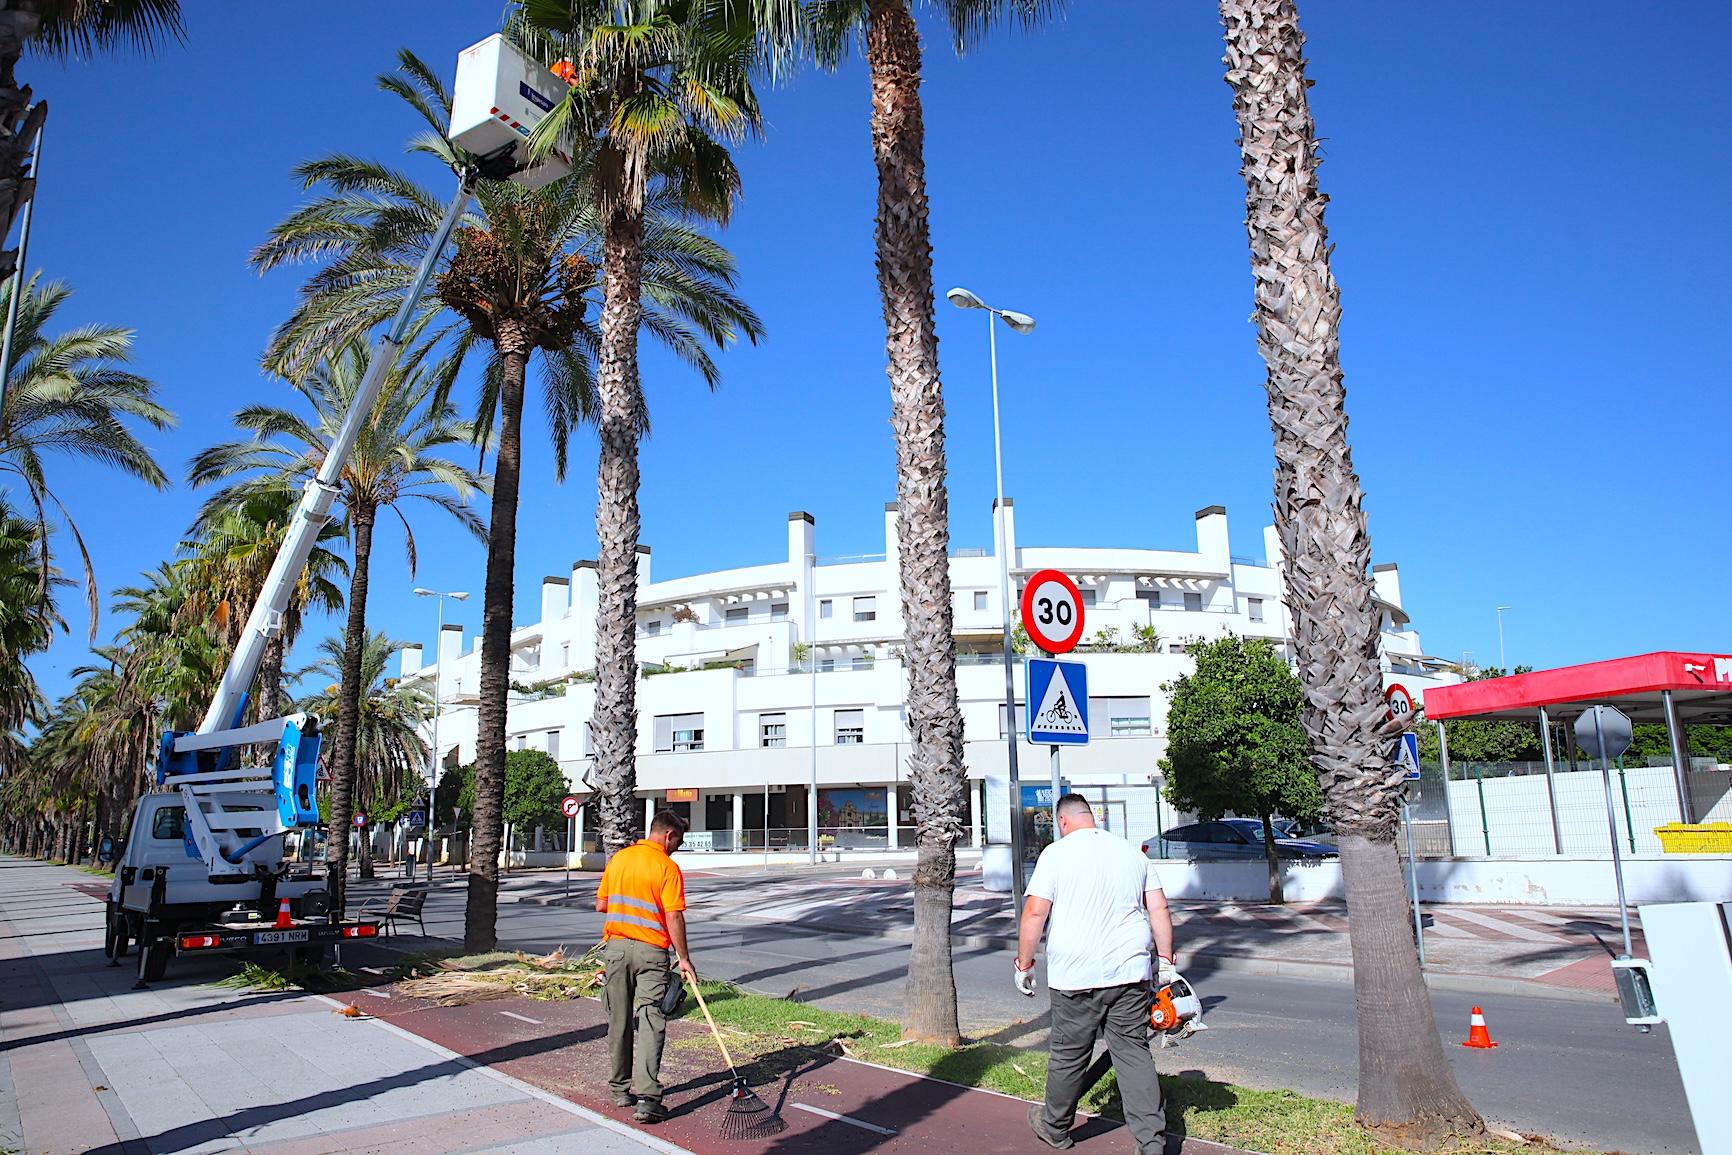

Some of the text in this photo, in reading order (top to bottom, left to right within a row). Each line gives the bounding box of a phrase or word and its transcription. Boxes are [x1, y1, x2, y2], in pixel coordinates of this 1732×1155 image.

[1038, 597, 1072, 626] 30
[1392, 699, 1408, 715] 30
[260, 931, 308, 943] 4391 NRM
